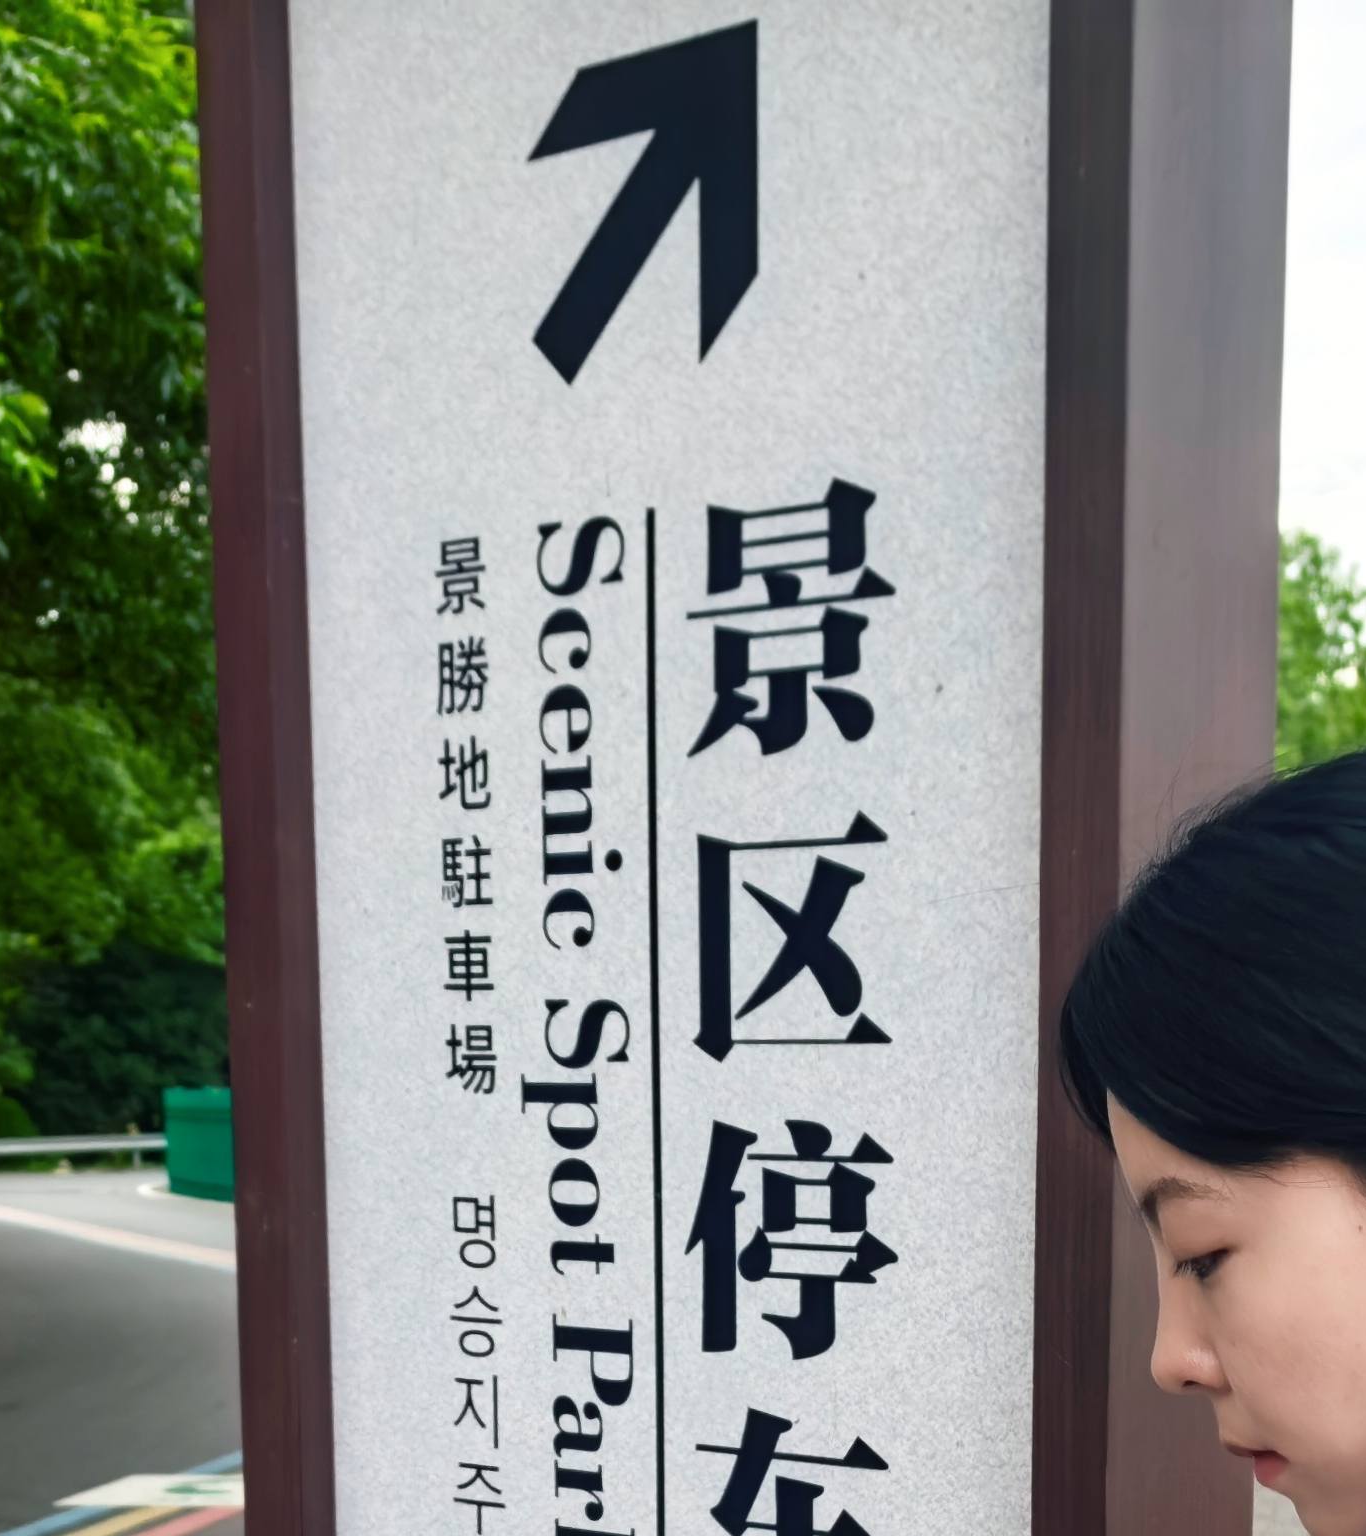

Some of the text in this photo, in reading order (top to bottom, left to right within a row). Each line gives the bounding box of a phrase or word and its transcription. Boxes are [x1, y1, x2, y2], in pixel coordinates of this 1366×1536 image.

[434, 535, 498, 1097] 景勝地駐車場
[536, 515, 625, 950] Scenic
[520, 998, 630, 1276] Spot
